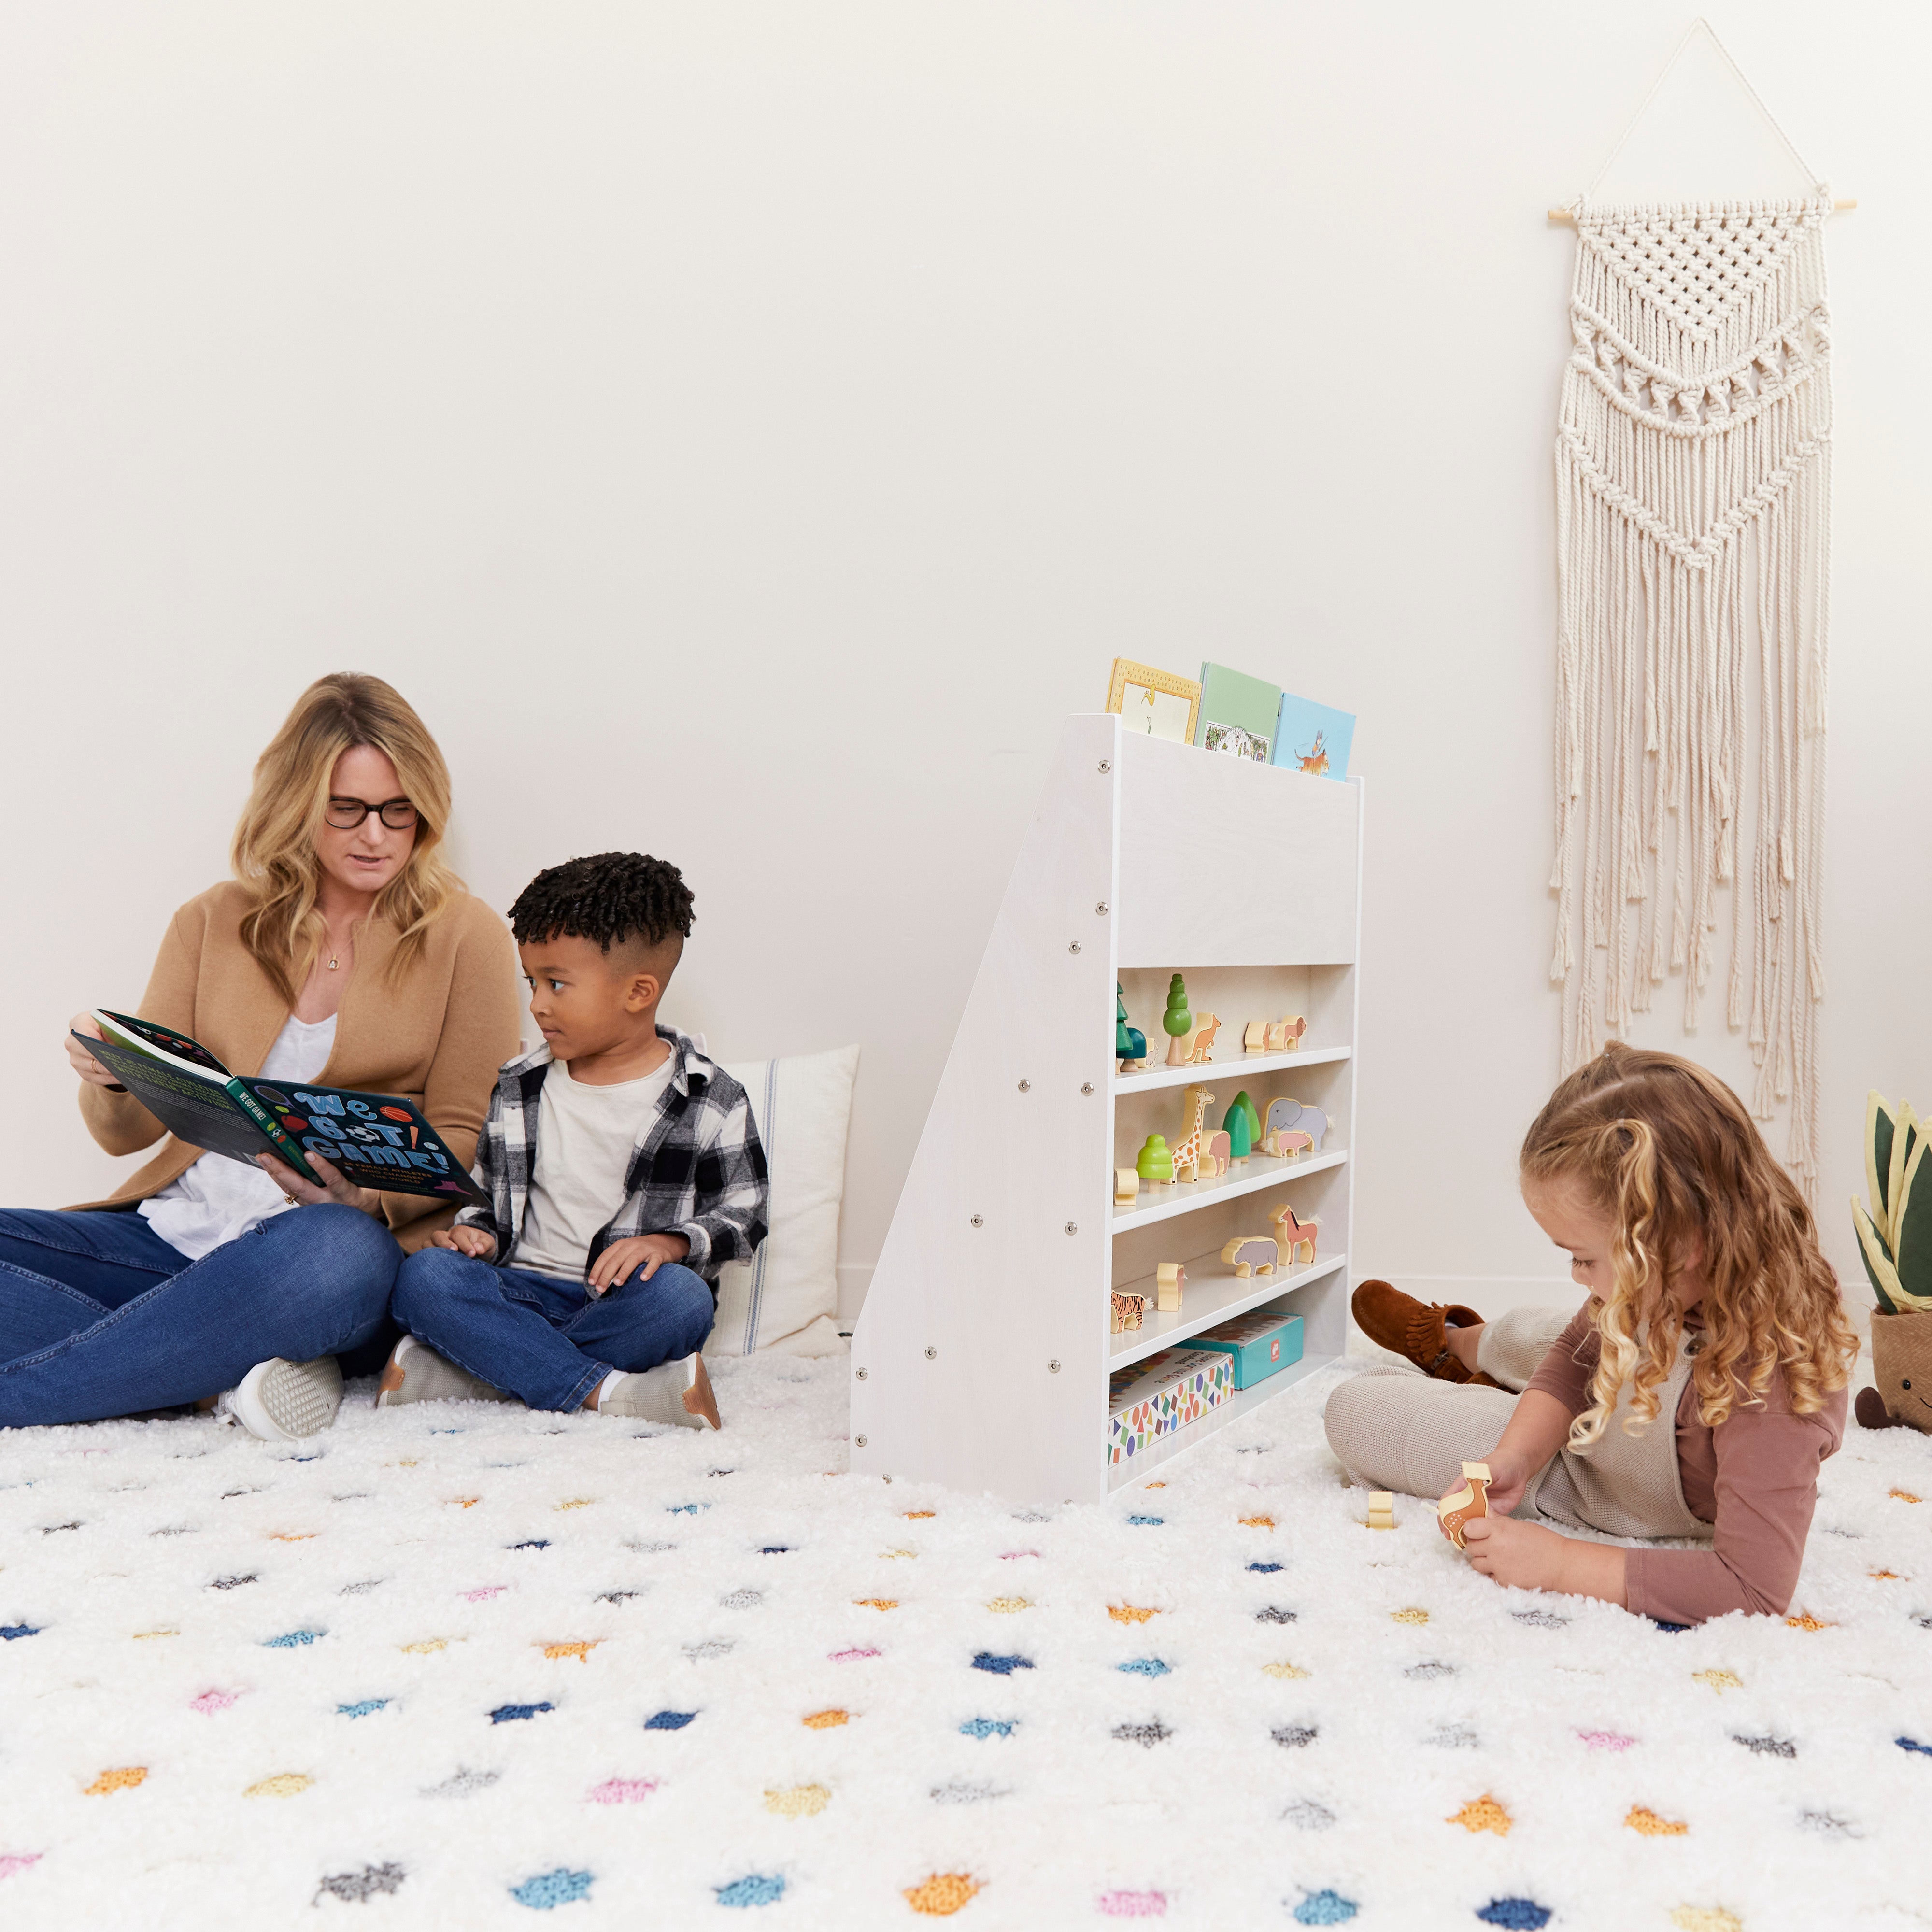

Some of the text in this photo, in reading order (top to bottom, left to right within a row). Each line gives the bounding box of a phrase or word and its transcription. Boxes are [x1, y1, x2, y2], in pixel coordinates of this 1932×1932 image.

[239, 1092, 267, 1121] WE GOT GAME!
[302, 1136, 450, 1174] GAME!
[355, 1163, 389, 1171] FEMALE
[391, 1168, 432, 1178] ATHLETES
[383, 1170, 425, 1180] CHANGED
[389, 1176, 421, 1184] WORLD
